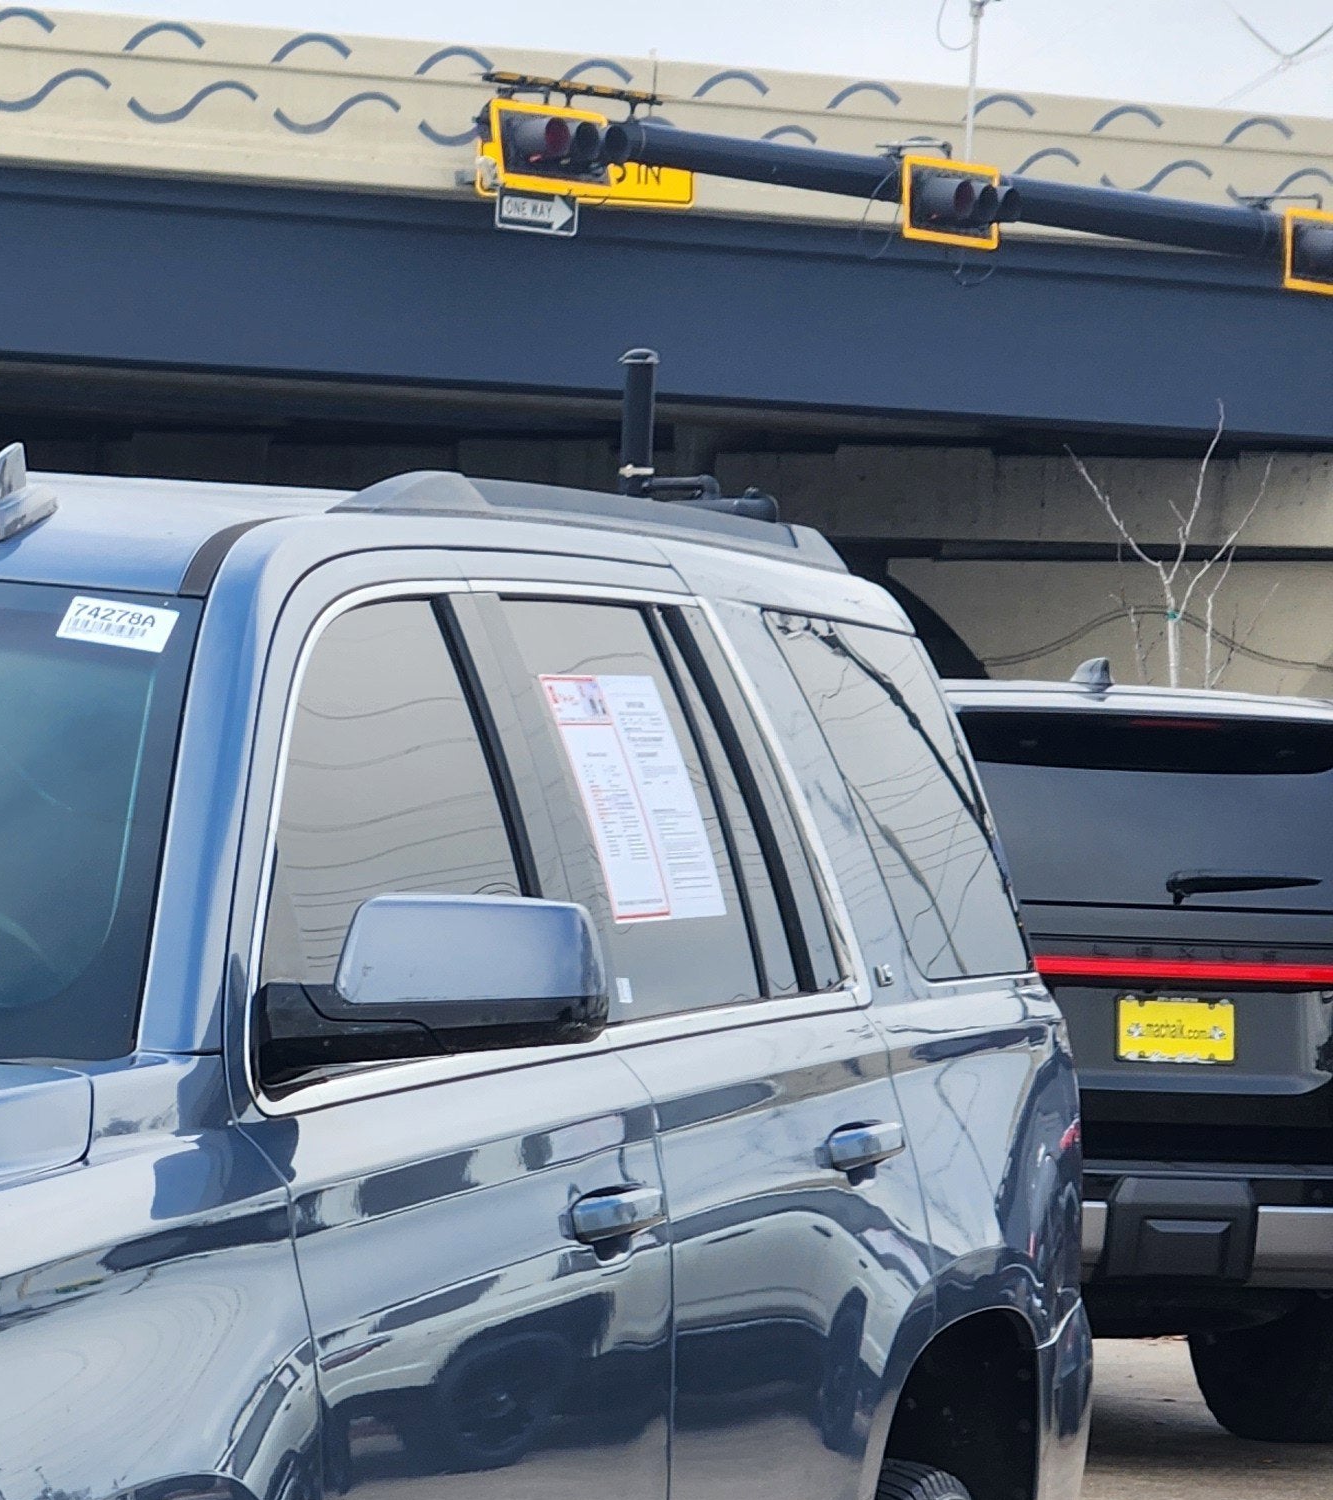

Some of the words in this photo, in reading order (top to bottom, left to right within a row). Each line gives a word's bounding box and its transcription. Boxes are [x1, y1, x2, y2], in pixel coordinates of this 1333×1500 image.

[505, 198, 528, 217] ONE
[532, 202, 553, 220] WAY
[74, 603, 156, 628] 74278A
